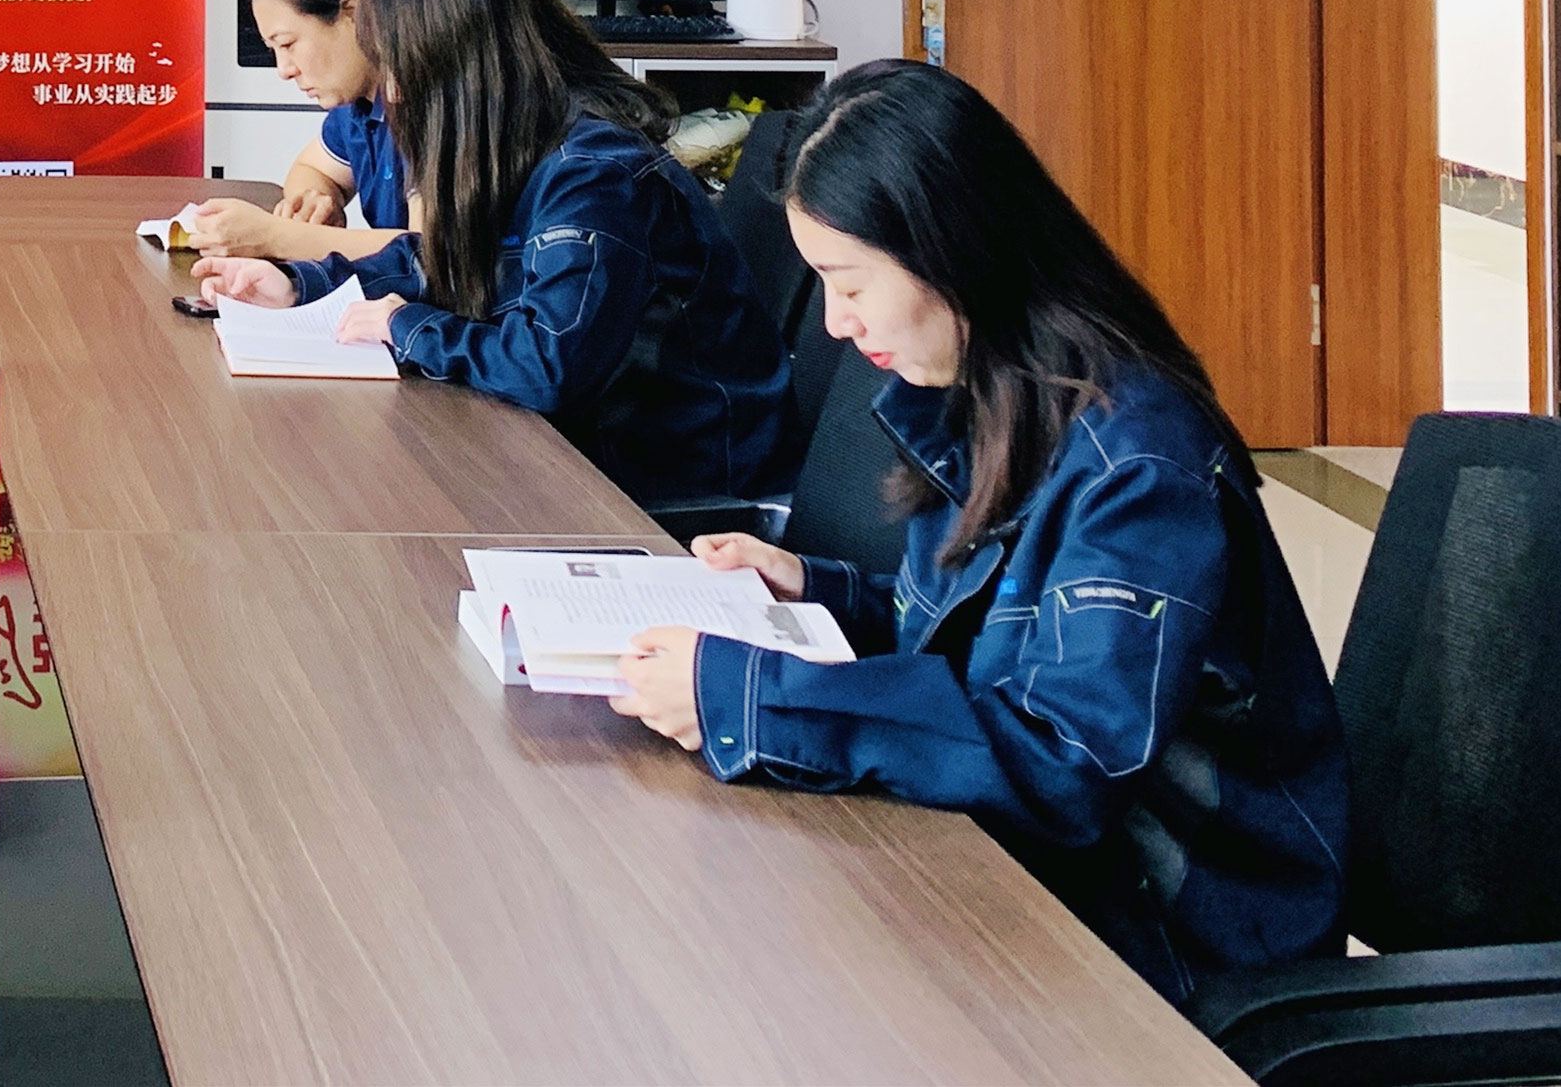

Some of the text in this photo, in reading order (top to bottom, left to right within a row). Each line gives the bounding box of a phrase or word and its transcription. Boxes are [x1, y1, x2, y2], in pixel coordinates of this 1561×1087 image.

[33, 83, 178, 107] 事业从实践起步
